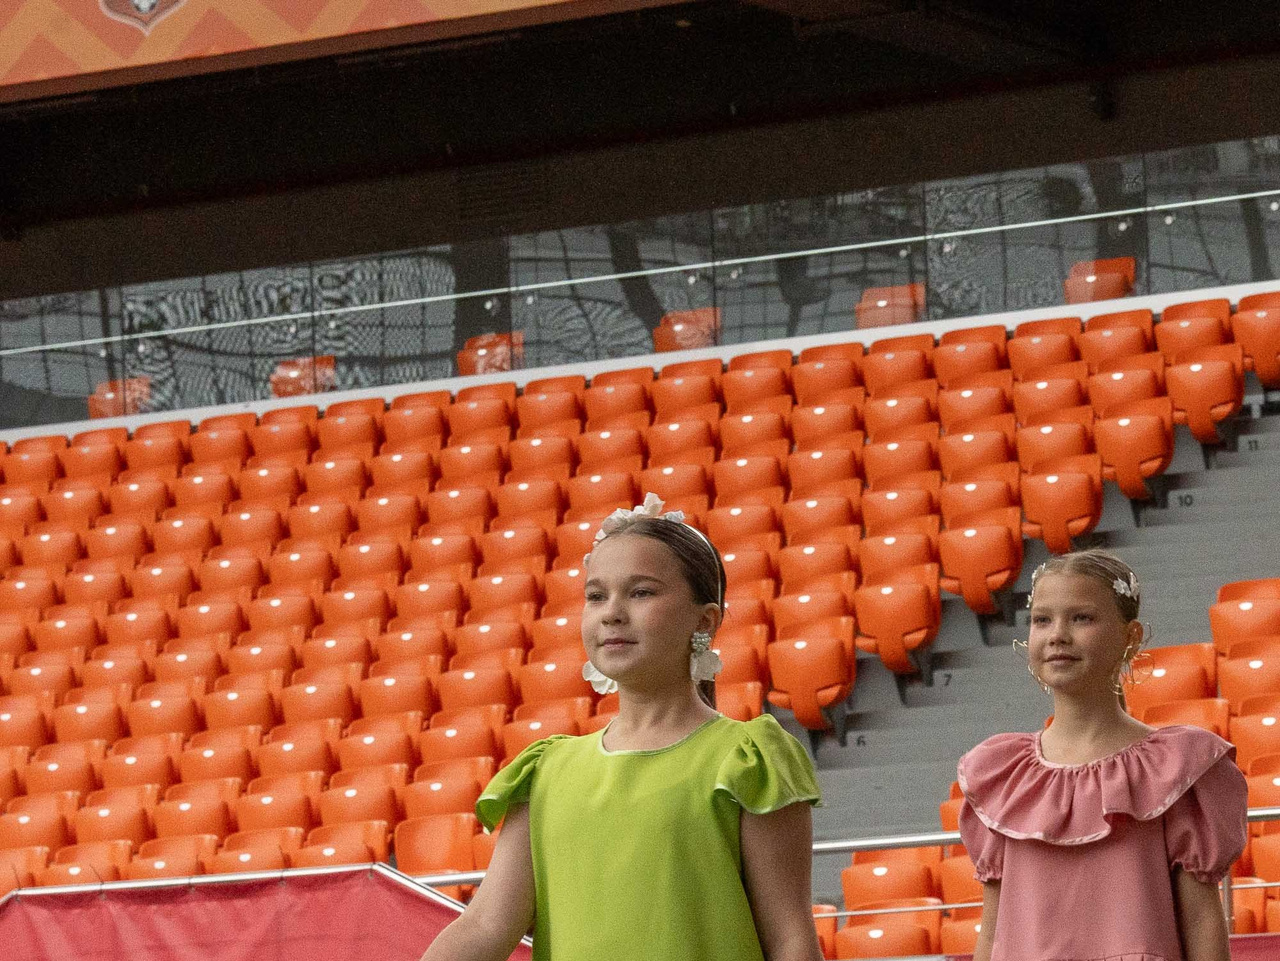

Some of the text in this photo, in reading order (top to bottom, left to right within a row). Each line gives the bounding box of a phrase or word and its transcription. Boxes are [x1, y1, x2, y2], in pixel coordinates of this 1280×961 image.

[1248, 439, 1259, 451] 11
[1178, 494, 1194, 507] 10
[943, 673, 953, 686] 7
